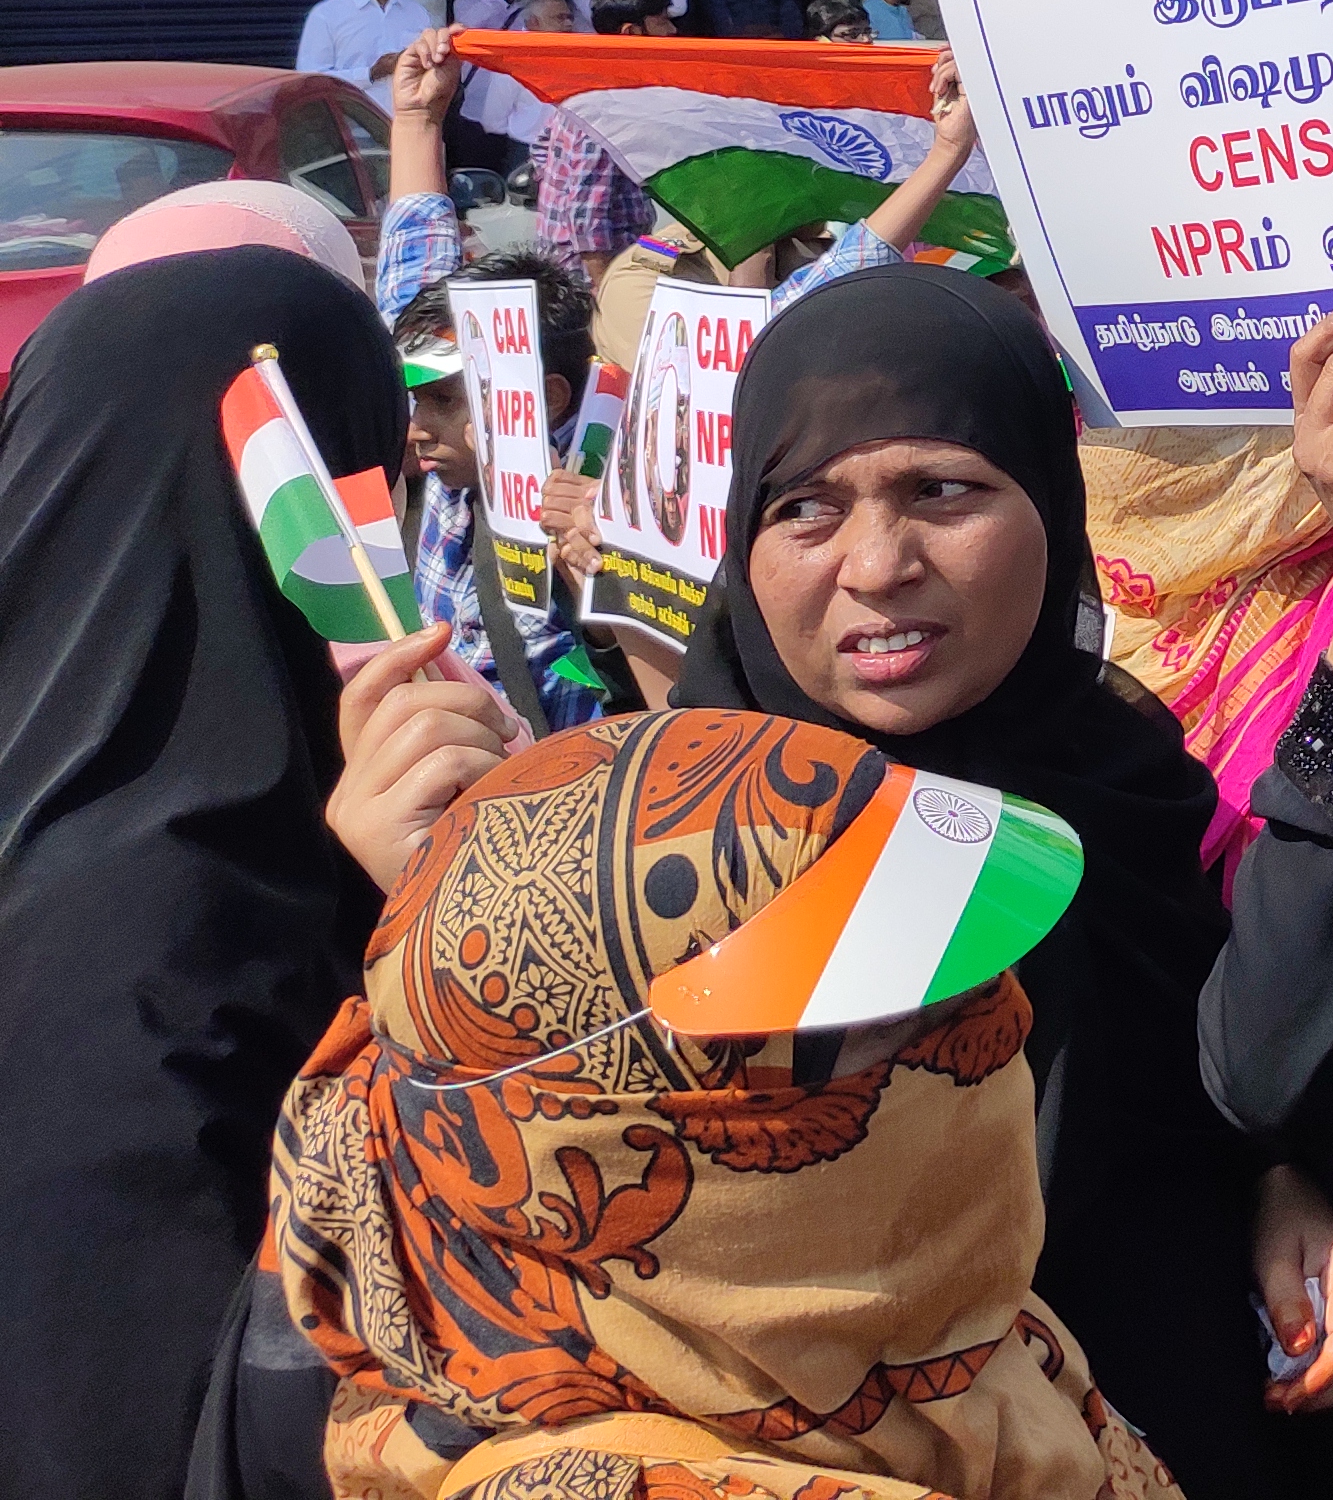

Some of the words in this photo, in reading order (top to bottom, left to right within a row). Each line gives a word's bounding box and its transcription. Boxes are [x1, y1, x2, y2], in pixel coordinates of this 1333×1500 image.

[1022, 63, 1156, 140] பாலும்
[1152, 215, 1295, 282] NPRம்
[491, 307, 532, 355] CAA
[1094, 304, 1203, 356] தமிழ்நாடு
[1176, 362, 1266, 400] அரசியல்
[496, 388, 538, 439] NPR
[500, 471, 542, 522] NRC
